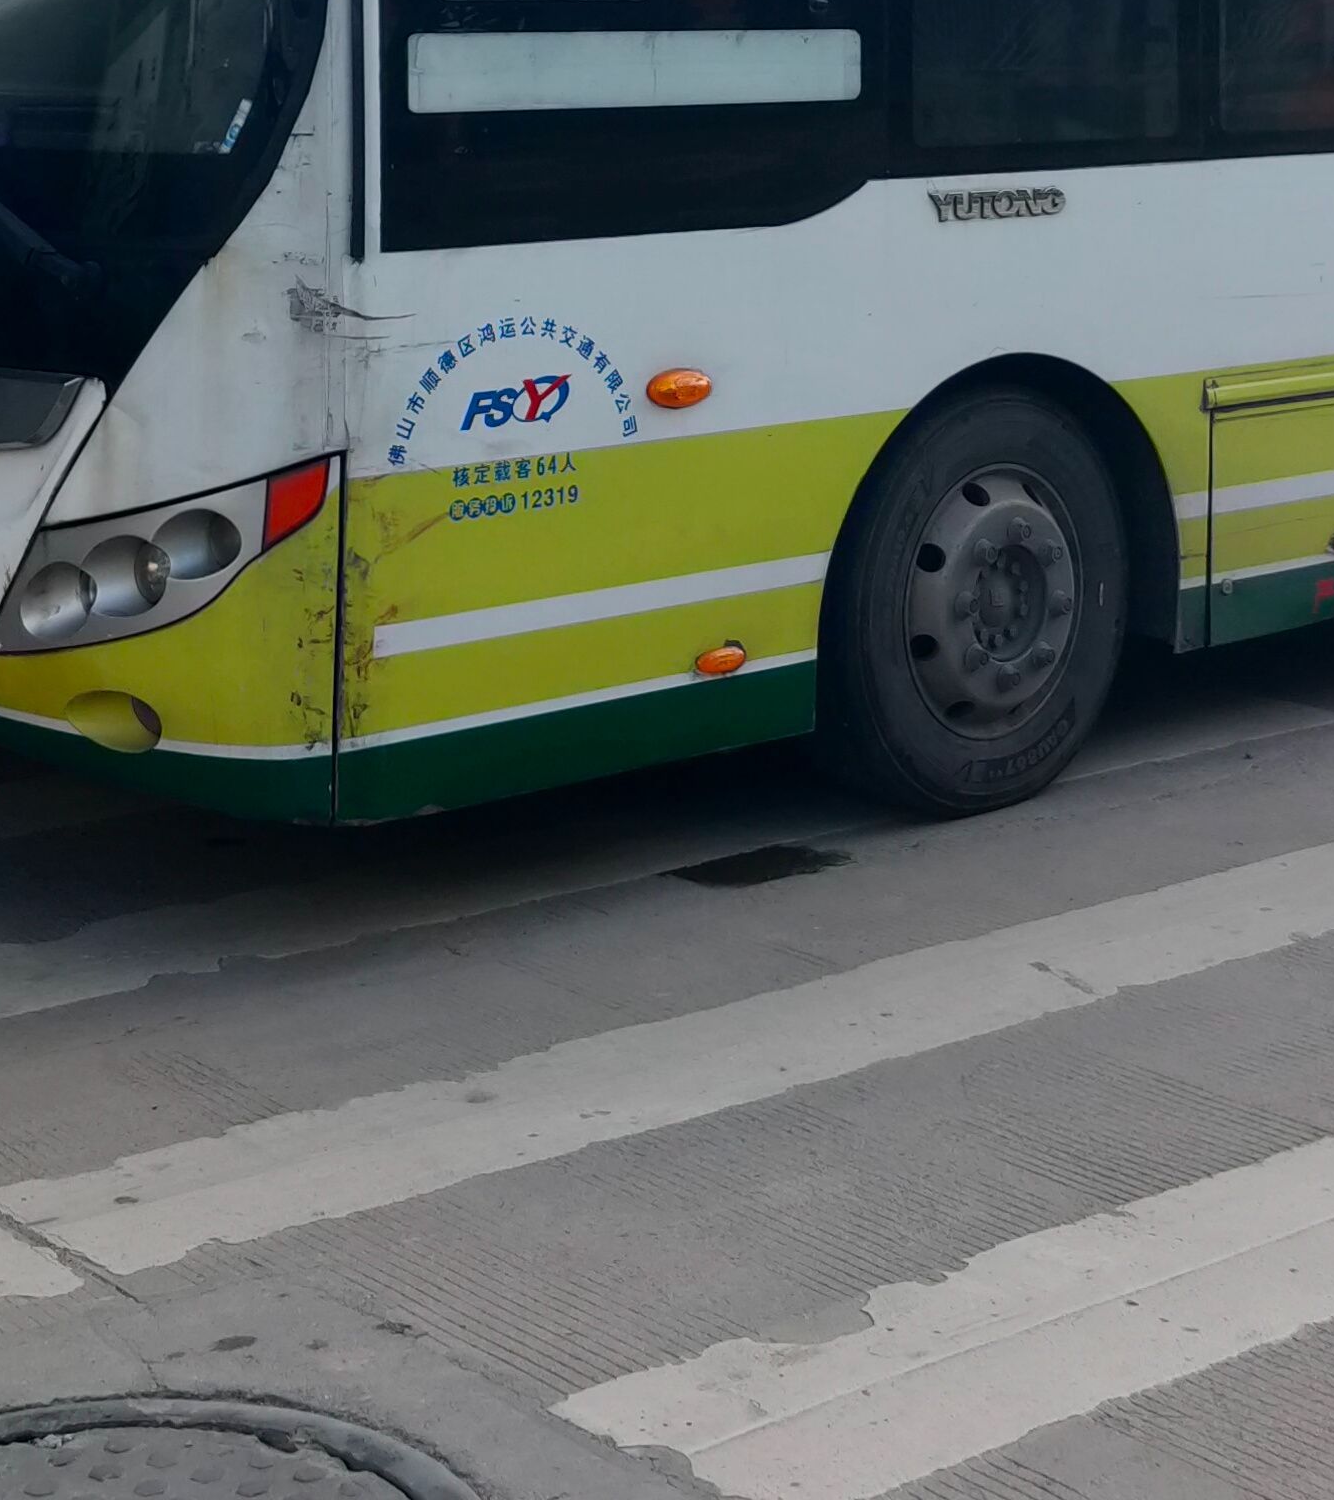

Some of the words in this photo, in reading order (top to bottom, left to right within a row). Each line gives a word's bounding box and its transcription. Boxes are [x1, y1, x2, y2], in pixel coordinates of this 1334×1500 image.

[927, 187, 1066, 222] YUTONG
[387, 316, 638, 466] 佛山市顺德区鸿运公共交通有限公司
[452, 452, 577, 487] 核定载客64人
[449, 492, 516, 520] 服务投诉
[521, 484, 578, 510] 12319
